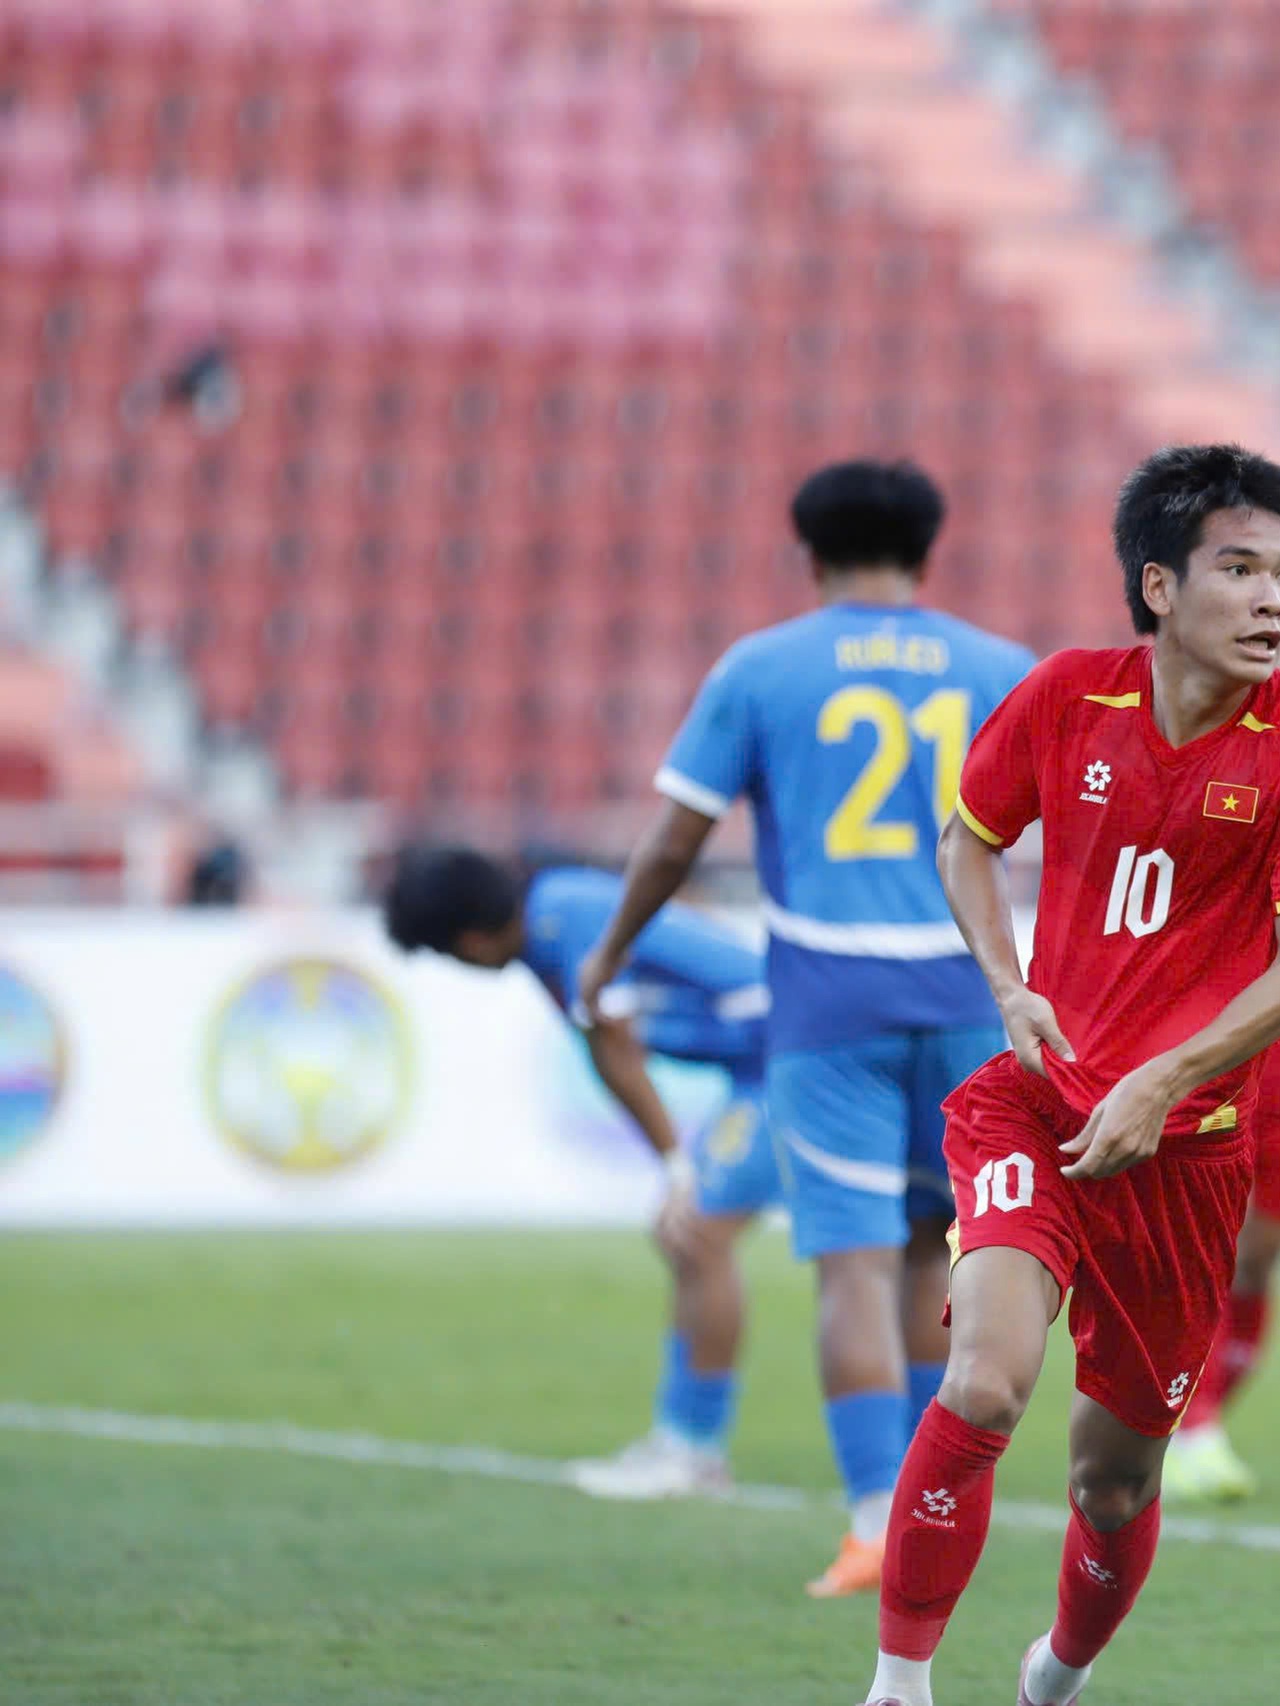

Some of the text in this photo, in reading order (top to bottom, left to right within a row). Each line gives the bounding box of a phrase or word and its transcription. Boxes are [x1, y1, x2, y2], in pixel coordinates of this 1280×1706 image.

[817, 684, 971, 862] 21
[1103, 845, 1175, 939] 10
[973, 1152, 1035, 1218] 10
